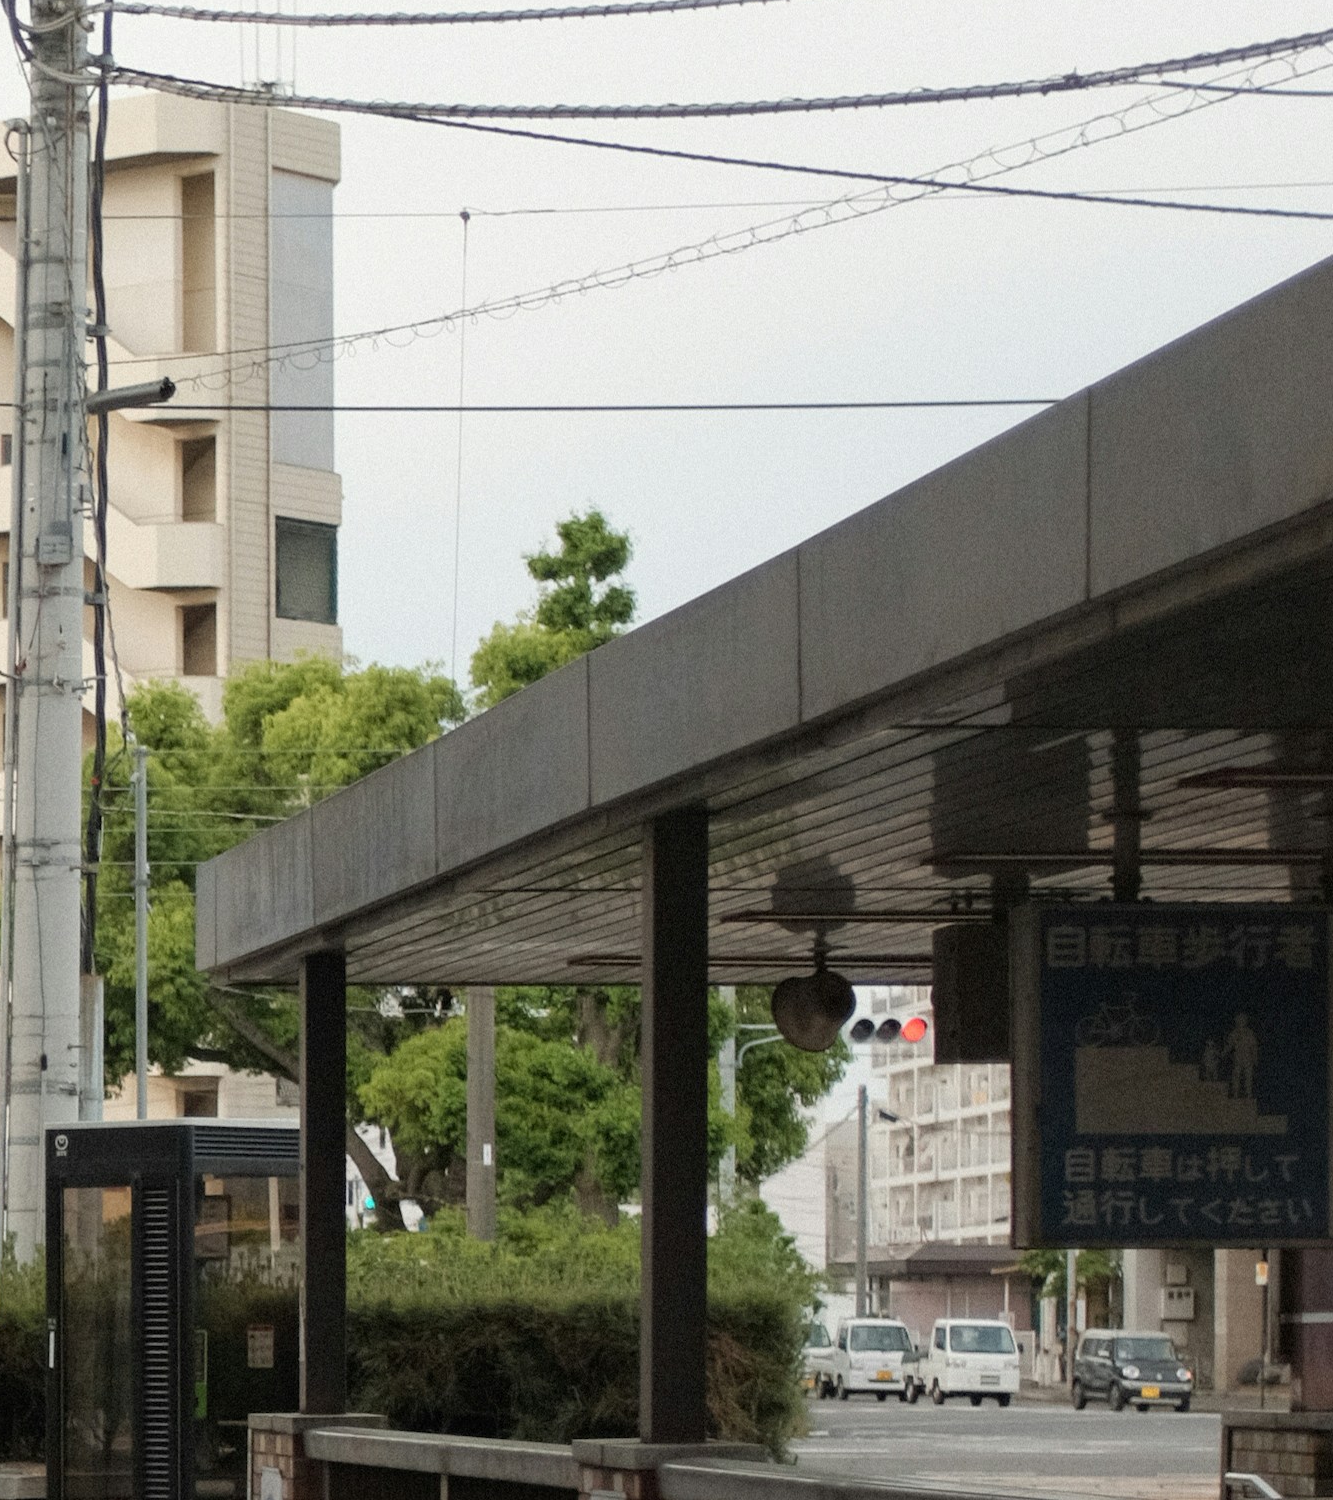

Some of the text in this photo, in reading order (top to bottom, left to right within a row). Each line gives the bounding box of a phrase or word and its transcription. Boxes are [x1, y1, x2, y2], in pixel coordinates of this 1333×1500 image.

[1045, 923, 1320, 969] 自転車歩行者
[1063, 1146, 1301, 1183] 自転車は押して
[1060, 1190, 1314, 1226] 通行してください
